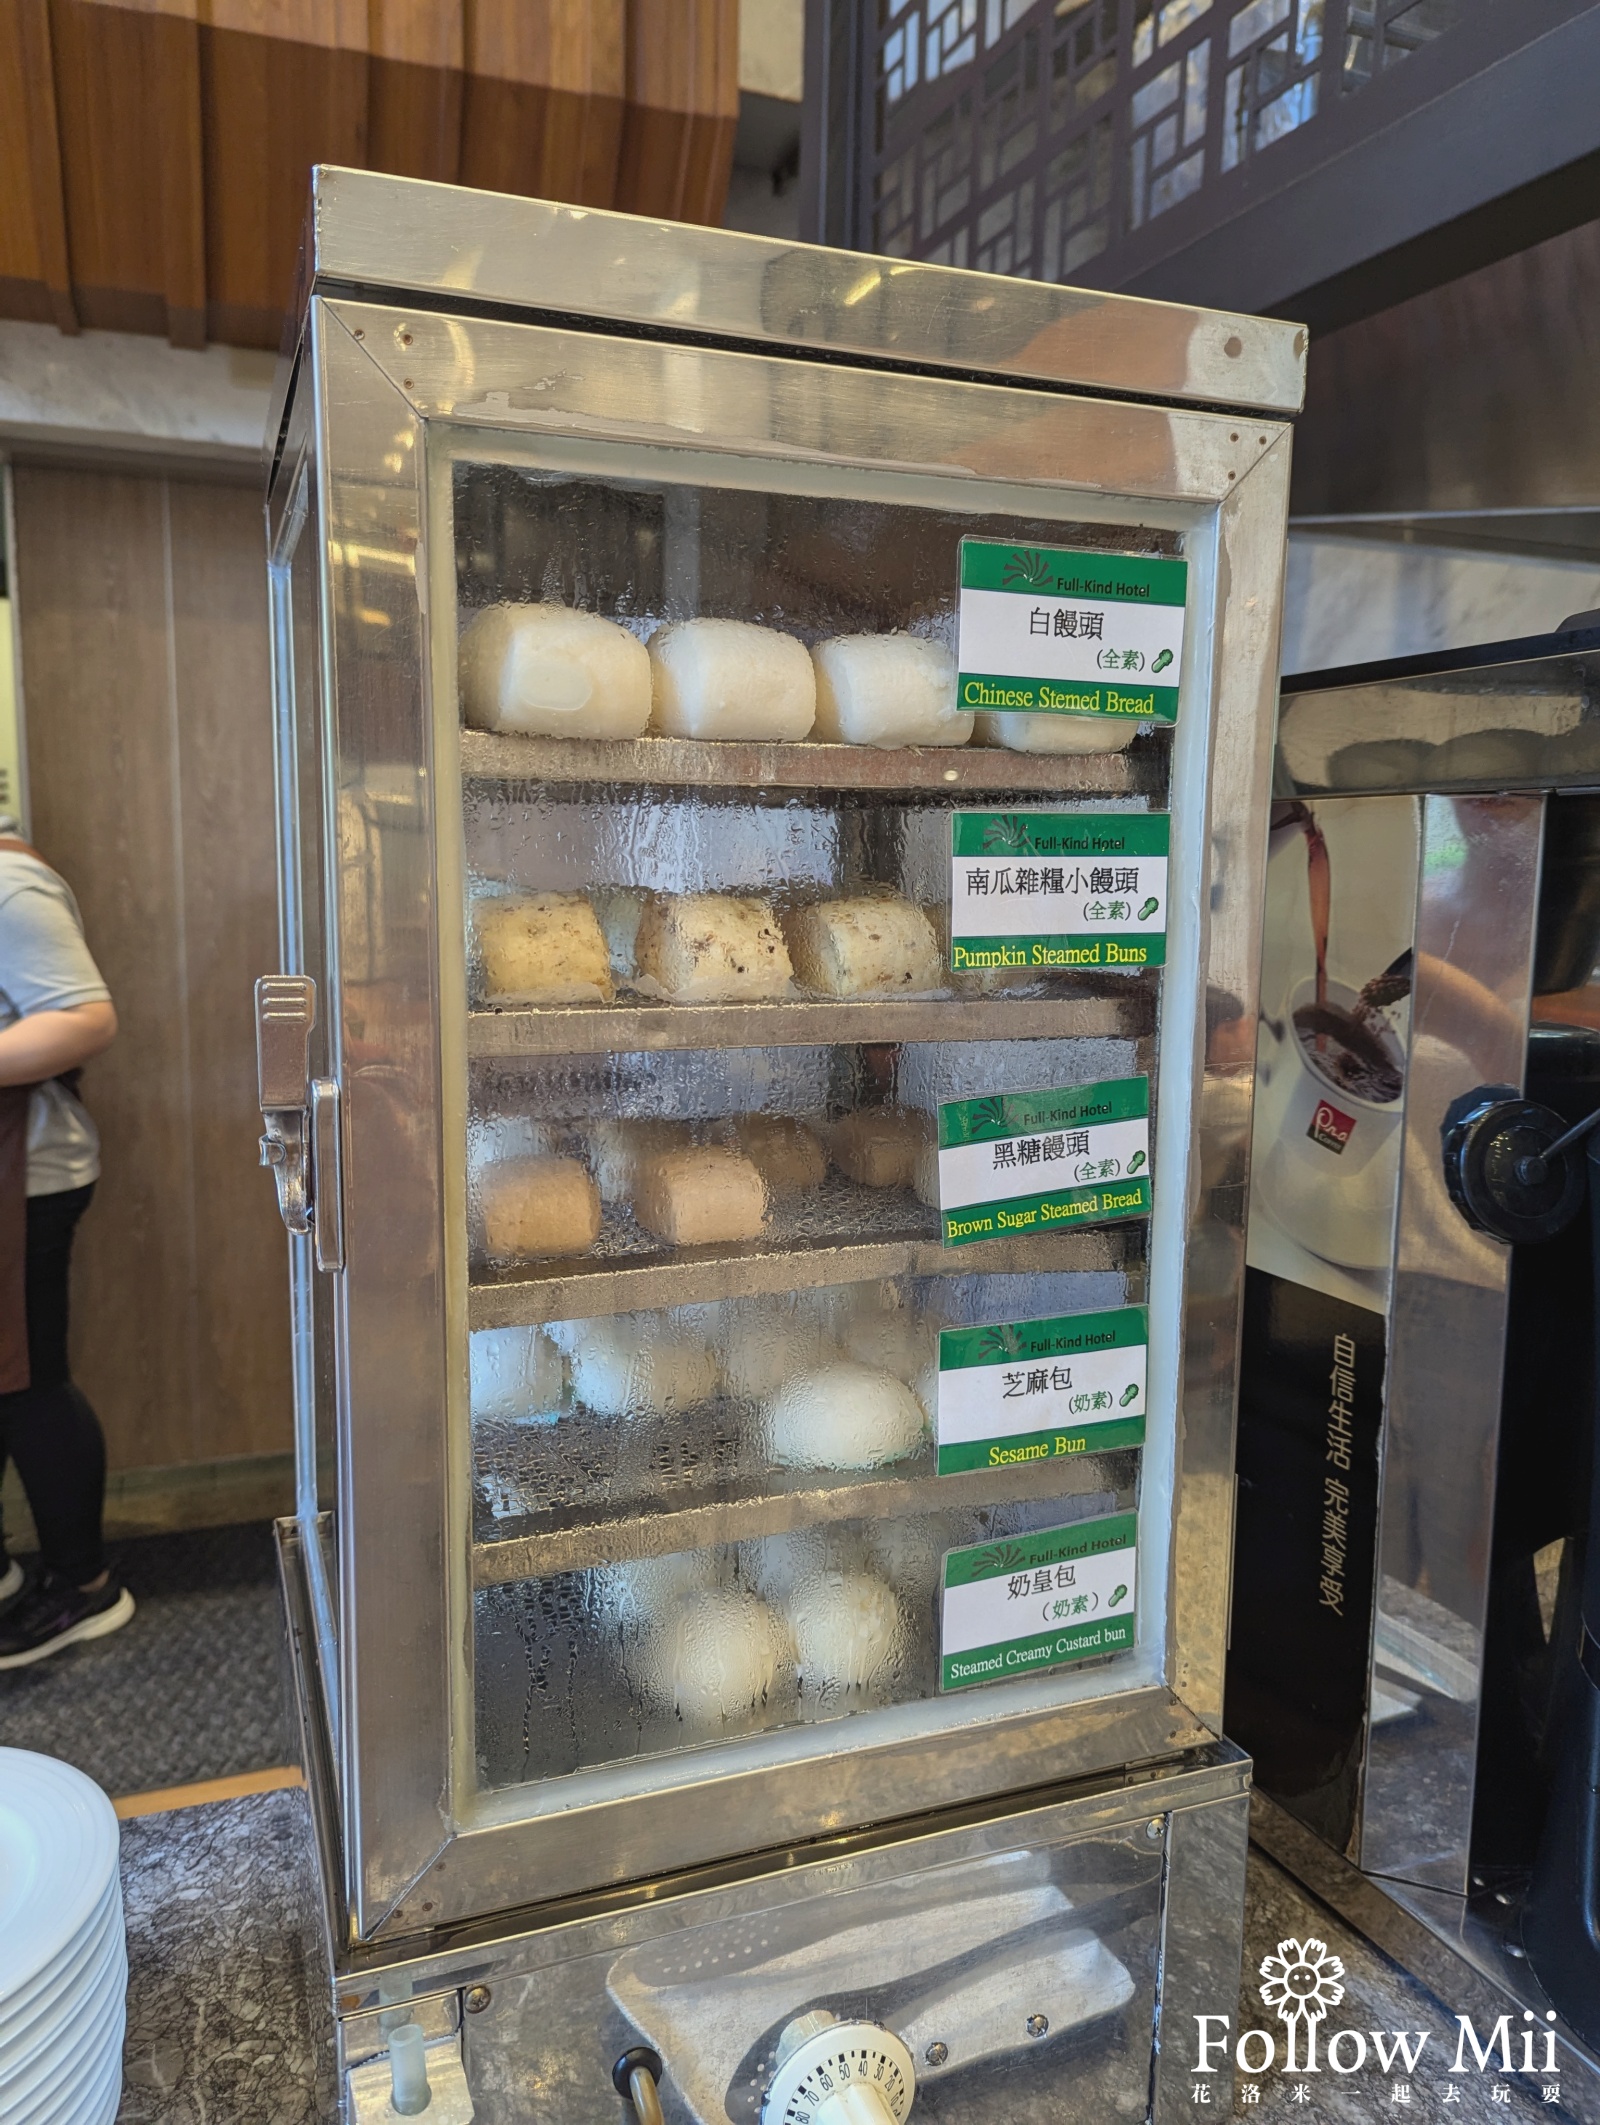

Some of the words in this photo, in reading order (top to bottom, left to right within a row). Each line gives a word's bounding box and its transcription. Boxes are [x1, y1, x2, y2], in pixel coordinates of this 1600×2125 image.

[1057, 577, 1113, 595] Full-Kind
[1115, 581, 1151, 598] Hotel
[1030, 607, 1105, 641] 白饅頭
[1096, 648, 1146, 672] (全素)
[964, 681, 1034, 706] Chinese
[1038, 686, 1101, 711] Stemed
[1105, 691, 1155, 715] Bread
[1034, 837, 1089, 850] Full-Kind
[1093, 836, 1125, 850] Hotel
[965, 866, 1140, 896] 南瓜雜糧小饅頭
[1082, 900, 1132, 922] (全素)
[953, 945, 1027, 968] Pumpkin
[1031, 943, 1101, 965] Steamed
[1105, 943, 1148, 963] Buns
[1023, 1107, 1077, 1126] Full-Kind
[1079, 1101, 1113, 1117] Hotel
[992, 1129, 1090, 1171] 黑糖饅頭
[1073, 1158, 1121, 1183] (全素)
[947, 1217, 993, 1238] Brown
[997, 1209, 1037, 1229] Sugar
[1040, 1196, 1098, 1220] Steamed
[1102, 1188, 1142, 1210] Bread
[1030, 1334, 1082, 1353] Full-Kind
[1085, 1330, 1116, 1346] Hotel
[1001, 1365, 1073, 1399] 芝麻包
[1068, 1390, 1113, 1415] (奶素)
[1325, 1332, 1356, 1471] 自信生活
[988, 1444, 1049, 1466] Sesame
[1054, 1436, 1086, 1455] Bun
[1029, 1545, 1088, 1565] Full-Kind
[1091, 1534, 1127, 1551] Hotel
[1318, 1476, 1350, 1617] 完美享受
[1007, 1564, 1077, 1600] 奶皇包
[1042, 1592, 1099, 1621] (奶素)
[950, 1654, 1003, 1680] Steamed
[1005, 1643, 1053, 1667] Creamy
[1056, 1629, 1102, 1654] Custard
[1104, 1627, 1126, 1642] bun
[795, 2110, 811, 2125] 80
[803, 2090, 820, 2107] 70
[819, 2073, 834, 2092] 60
[838, 2062, 851, 2081] 50
[857, 2060, 868, 2077] 40
[873, 2063, 885, 2081] 30
[884, 2074, 896, 2092] 20
